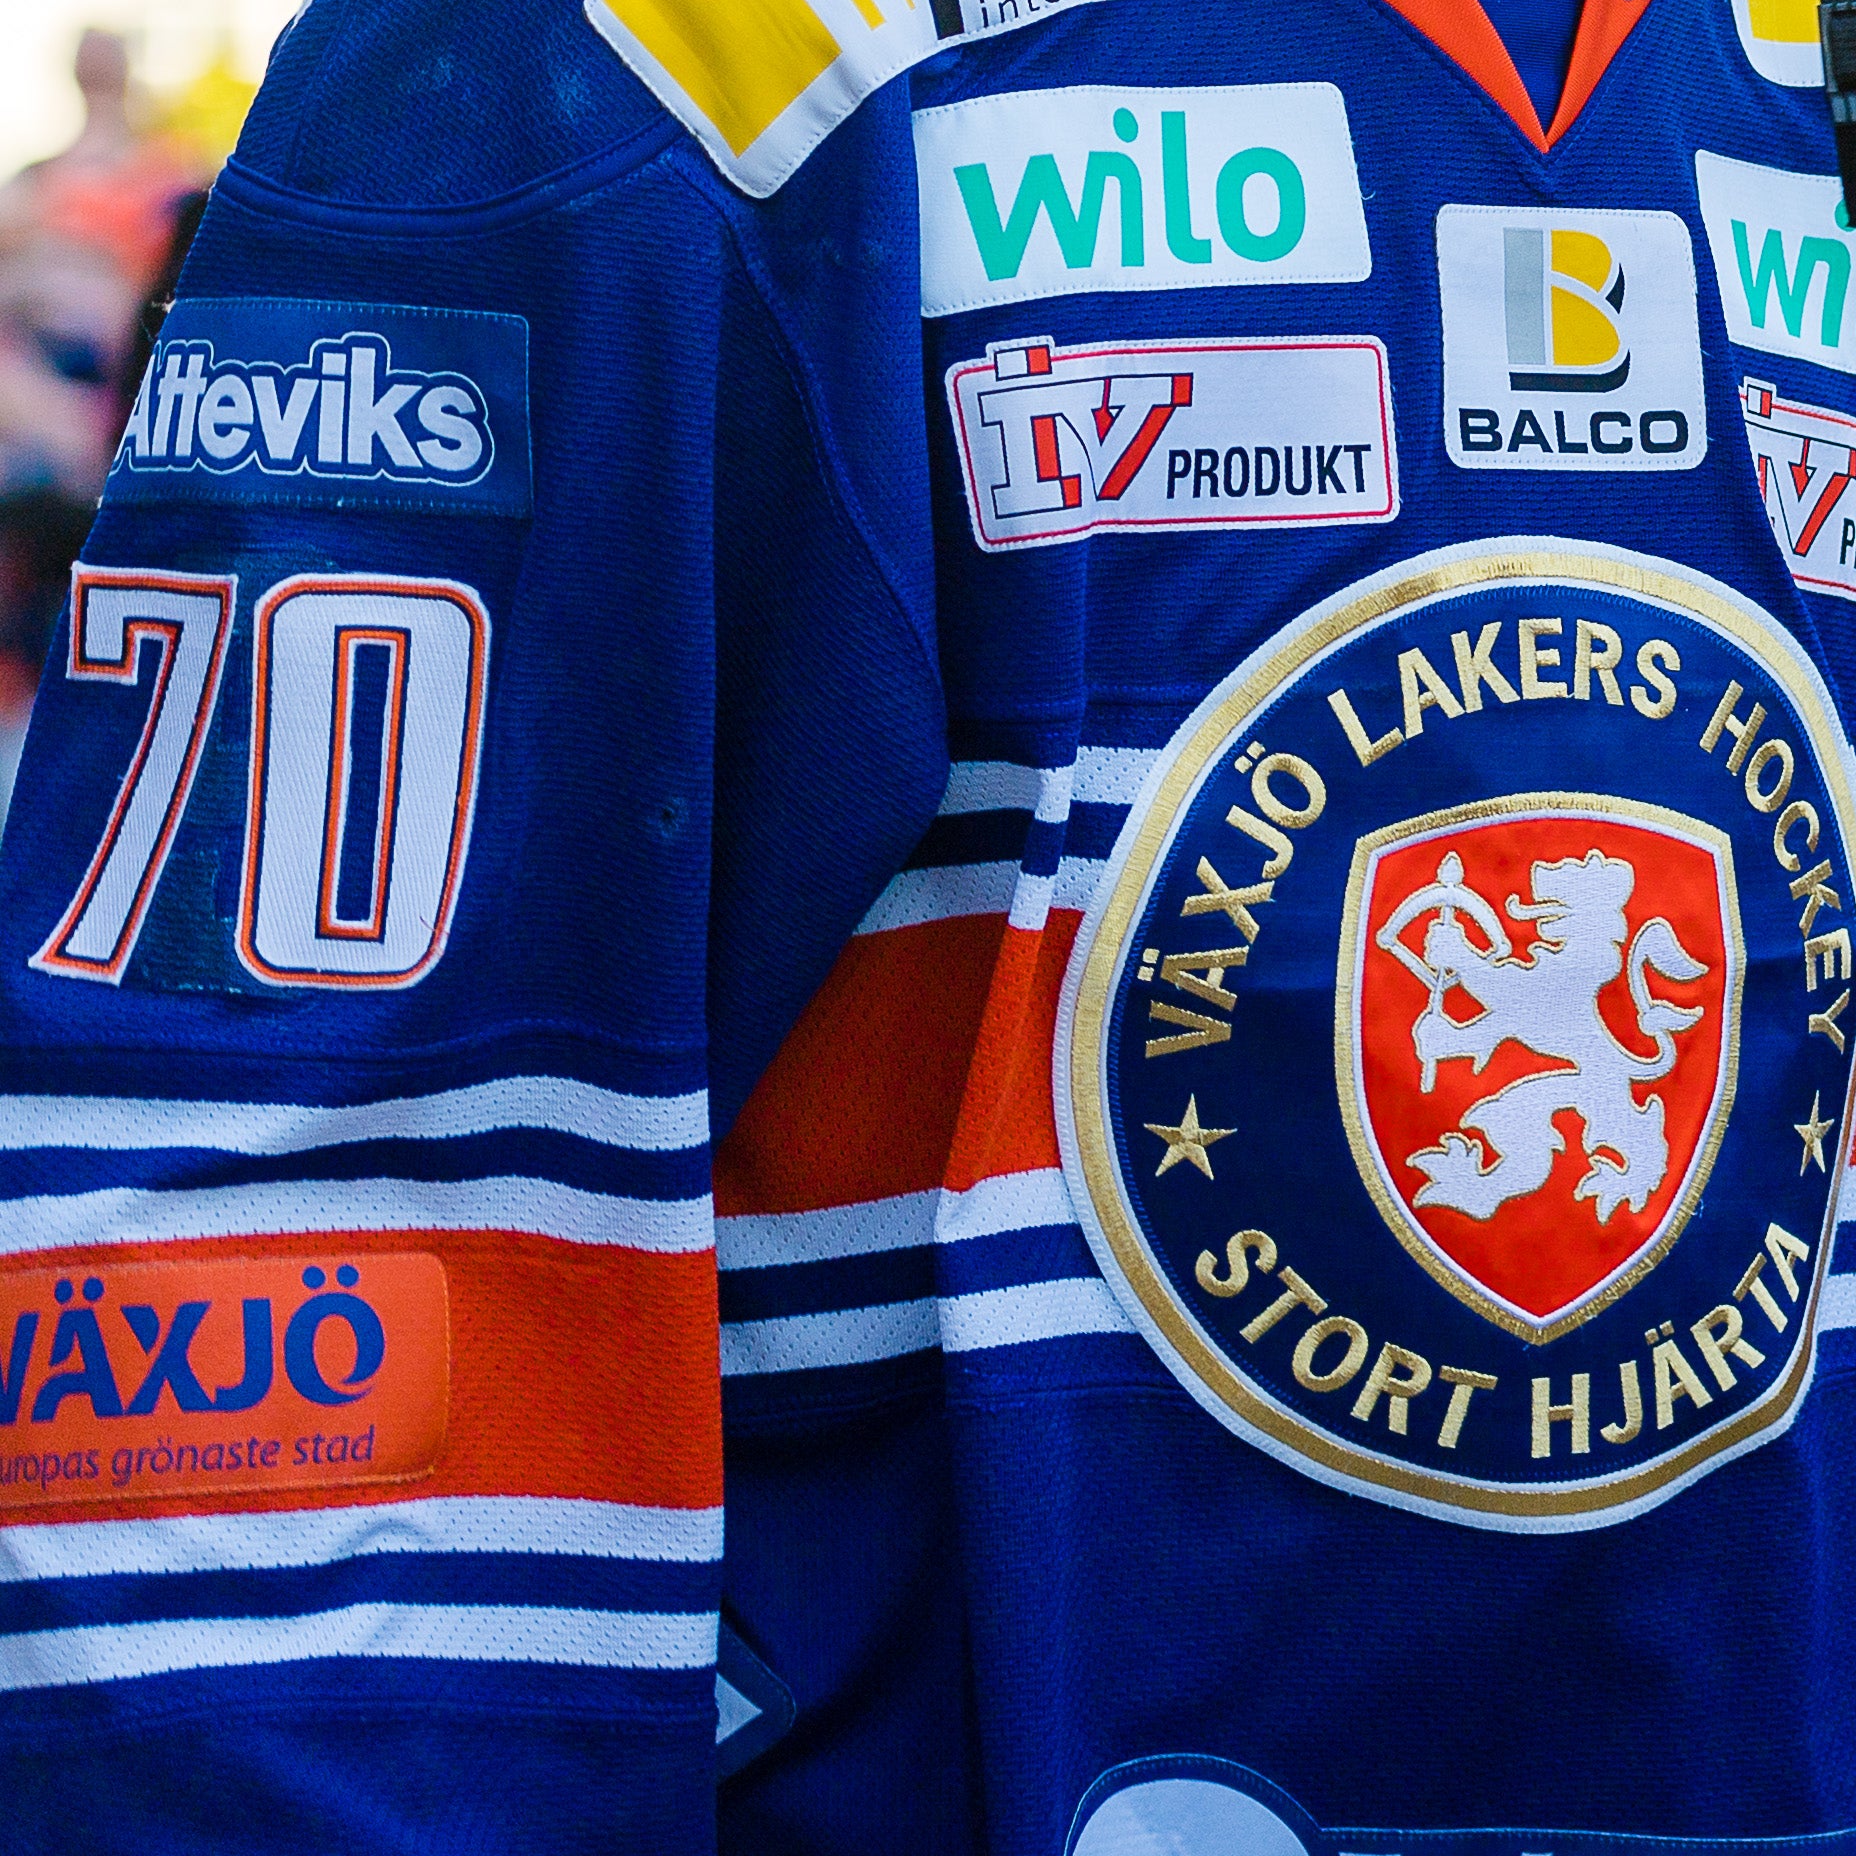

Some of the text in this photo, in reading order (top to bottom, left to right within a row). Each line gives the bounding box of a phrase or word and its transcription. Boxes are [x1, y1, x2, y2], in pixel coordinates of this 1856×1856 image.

[952, 106, 1307, 282] wilo
[1165, 443, 1372, 500] PRODUKT
[1457, 406, 1690, 455] BALCO
[28, 560, 493, 992] 70
[1136, 617, 1856, 1059] VÄXJÖ LAKERS HOCKEY
[1194, 1220, 1812, 1459] STORT HJÄRTA
[0, 1424, 376, 1490] uropas grönaste stad
